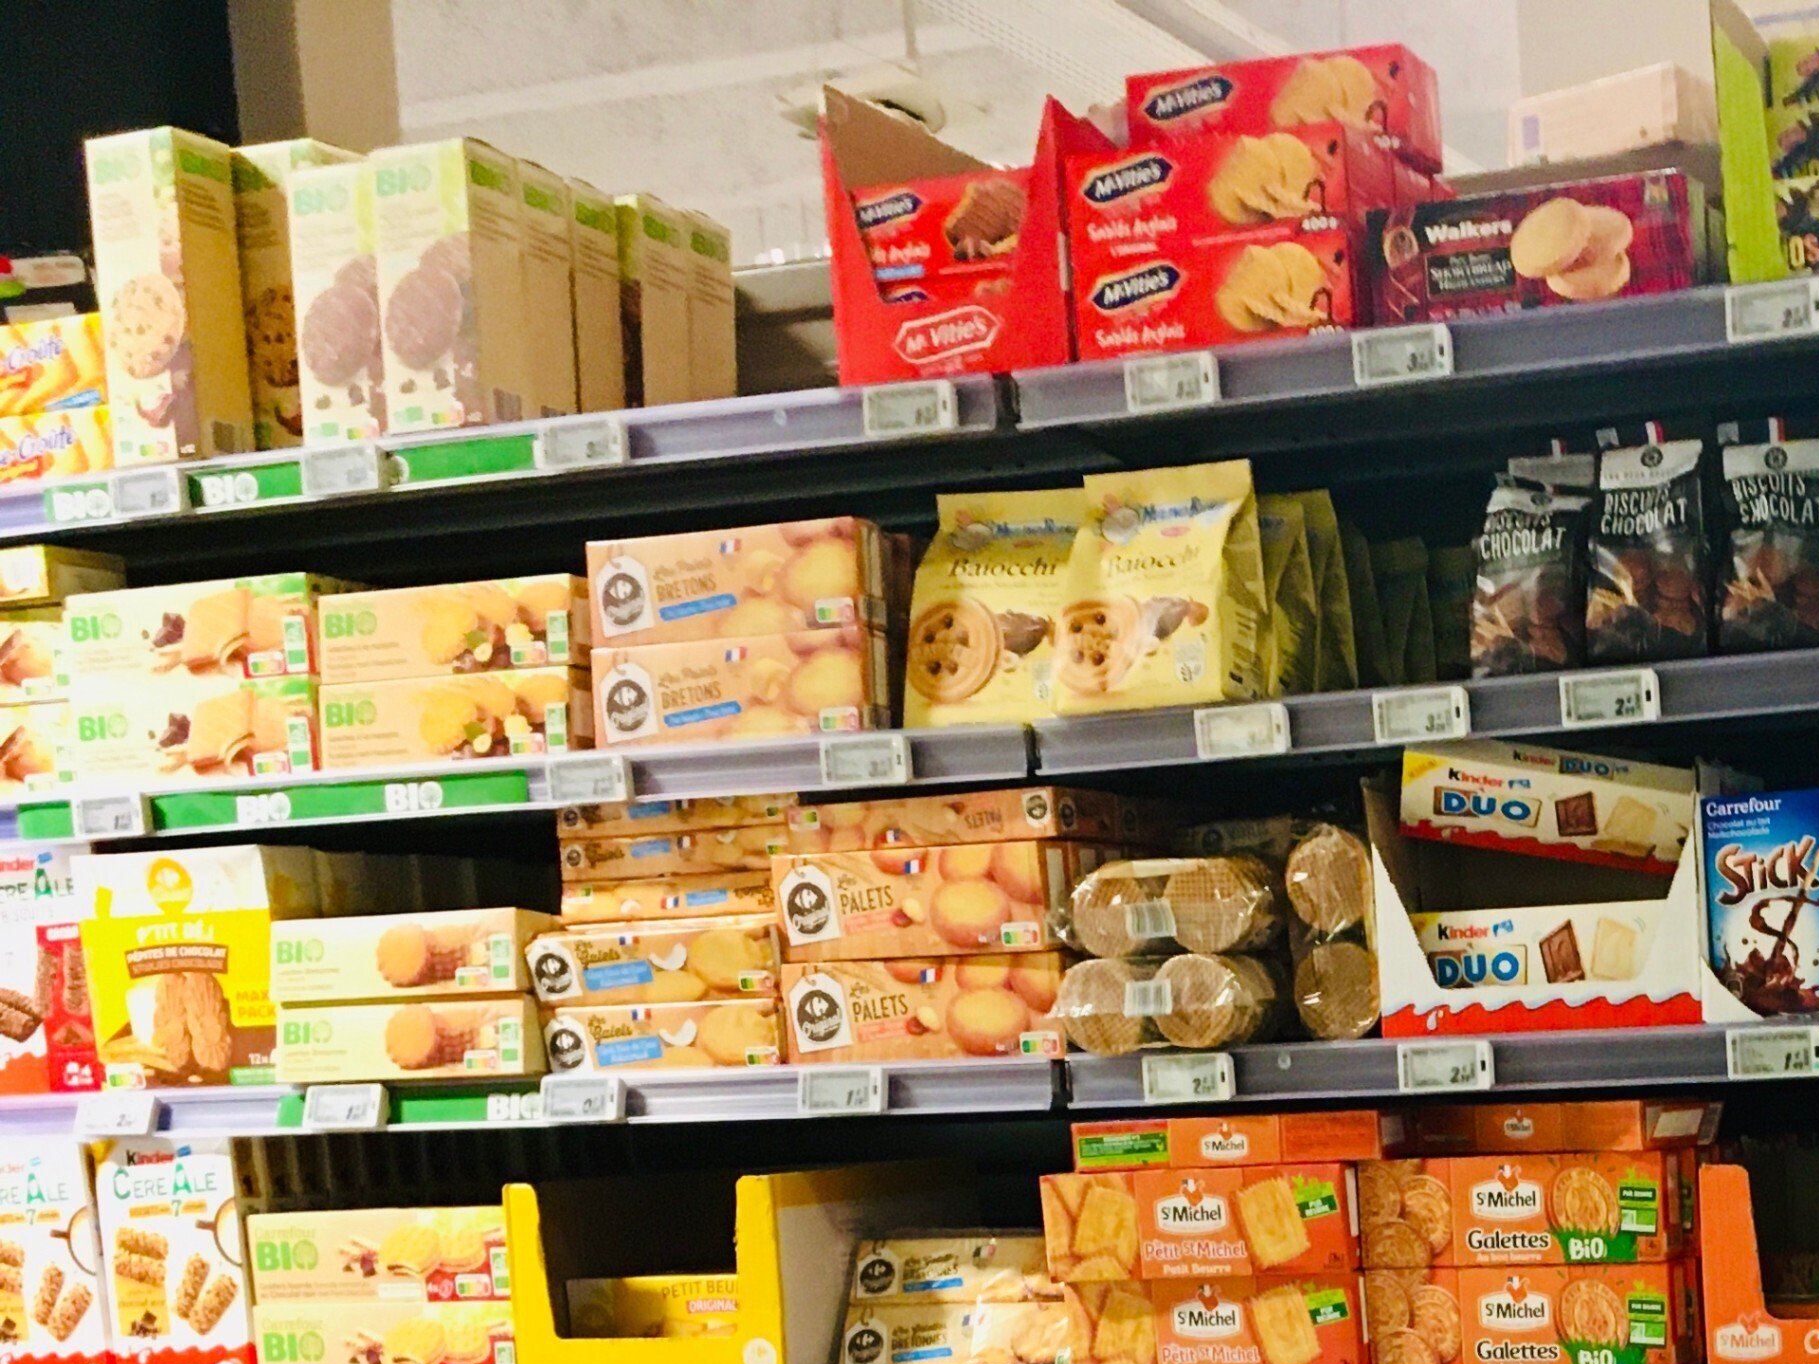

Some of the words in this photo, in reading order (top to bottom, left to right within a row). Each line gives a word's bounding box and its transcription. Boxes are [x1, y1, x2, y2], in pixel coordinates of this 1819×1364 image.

[1426, 220, 1512, 245] Walkers
[1601, 497, 1686, 535] CHOCOLAT
[949, 558, 1057, 578] Baiocchi
[656, 575, 717, 600] BRETONS
[661, 681, 721, 708] BRETONS
[1447, 767, 1503, 788] Kinder
[236, 792, 290, 821] BIO
[385, 781, 443, 810] BIO
[1440, 790, 1533, 821] DUO
[1706, 797, 1781, 818] Carrefour
[840, 887, 893, 913] PALETS
[1437, 922, 1489, 941] Kinder
[1437, 954, 1520, 985] DUO
[852, 995, 908, 1021] PALETS
[1144, 1241, 1181, 1261] Petit
[1469, 1230, 1549, 1251] Galettes
[256, 1241, 318, 1271] BIO
[263, 1332, 325, 1361] BIO
[1478, 1341, 1558, 1362] Galettes
